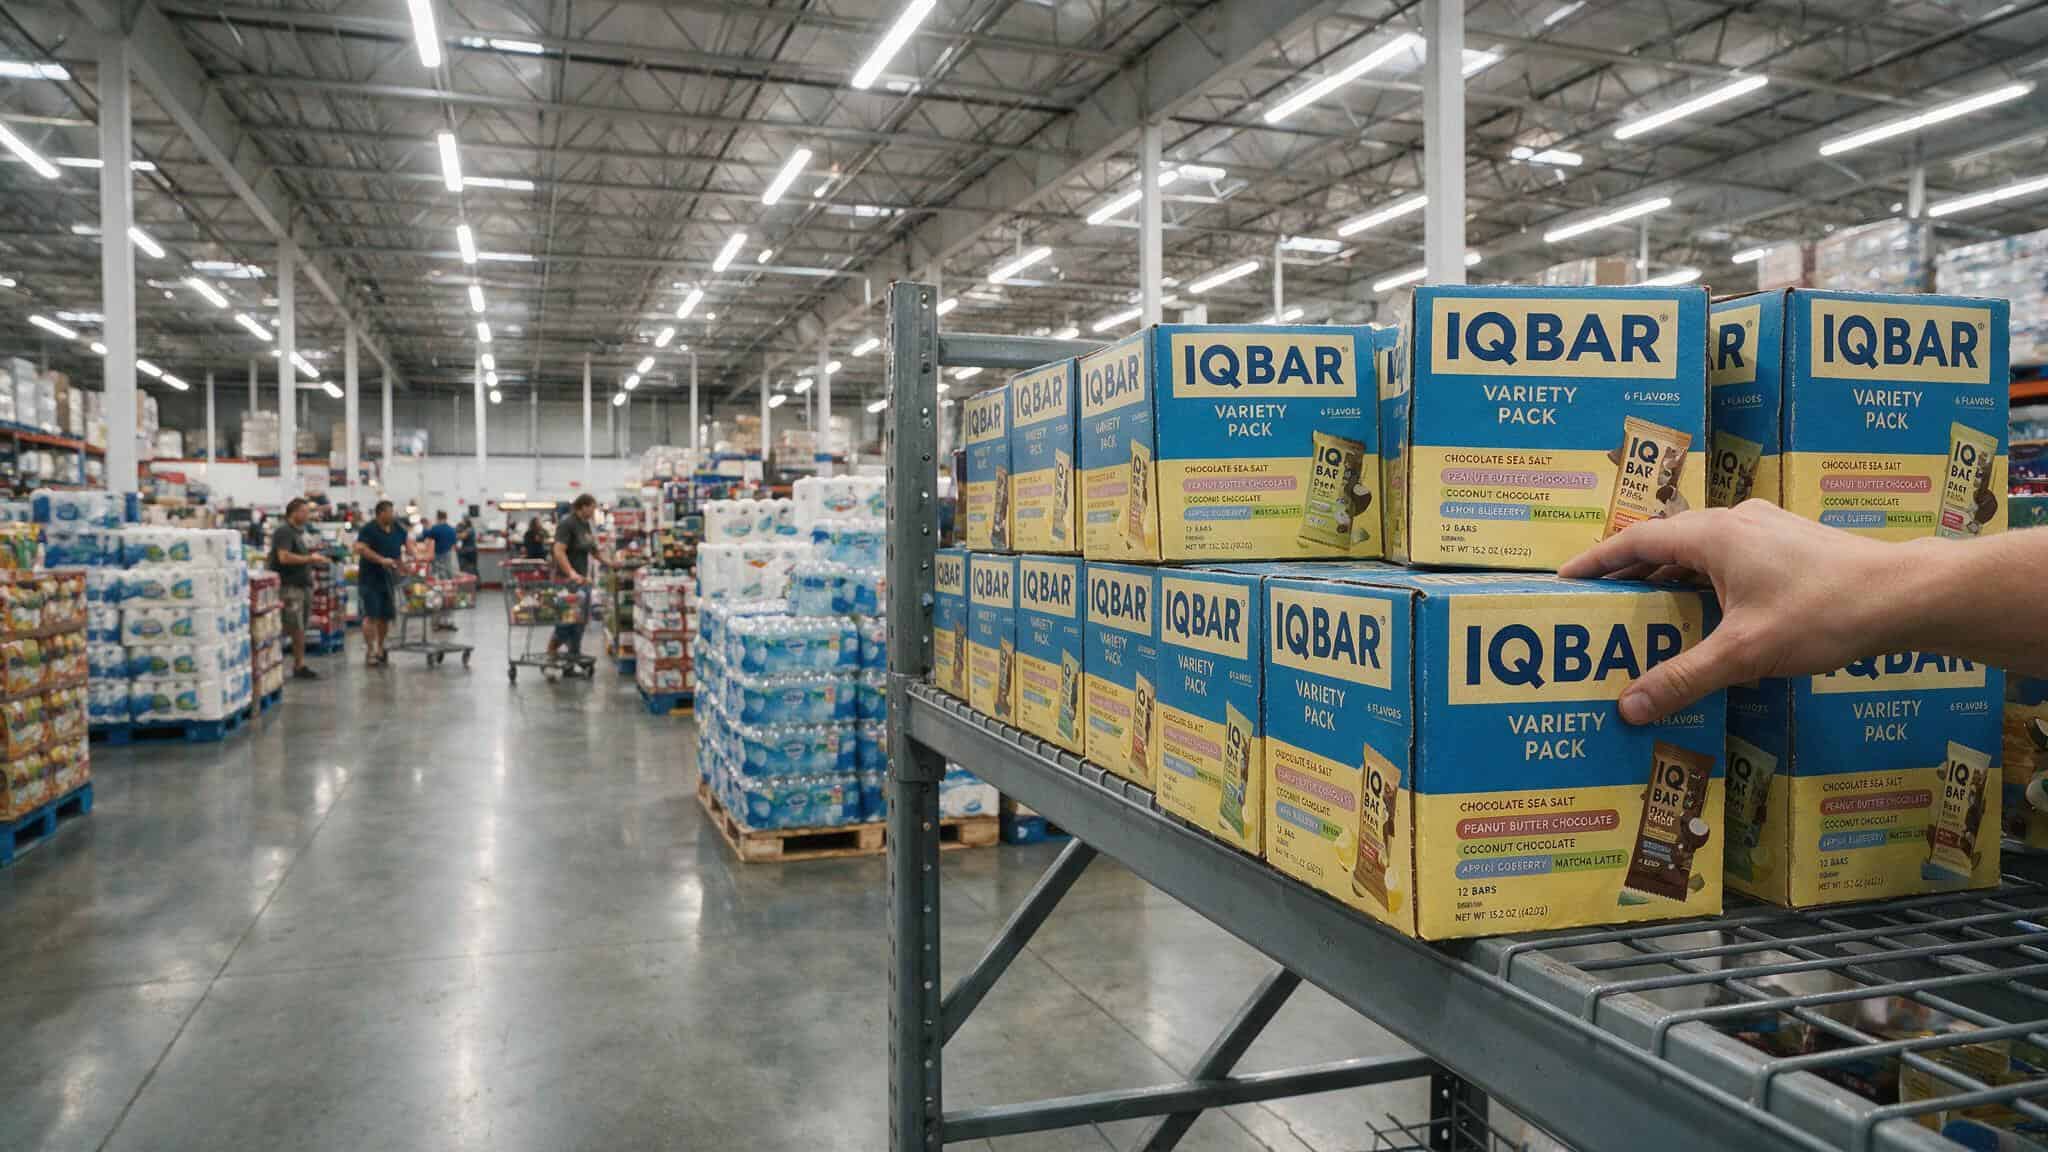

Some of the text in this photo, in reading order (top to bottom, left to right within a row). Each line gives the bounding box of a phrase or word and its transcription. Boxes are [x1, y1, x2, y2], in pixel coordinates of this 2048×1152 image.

[1446, 311, 1661, 366] IQBAR
[1823, 314, 1978, 370] IQBAR
[1184, 344, 1344, 388] IQBAR
[1085, 355, 1139, 407] IQBAR
[1015, 375, 1062, 418] IQBAR
[1483, 384, 1577, 404] VARIETY
[1624, 392, 1680, 401] 6 FLAVORS
[1853, 388, 1923, 408] VARIETY
[968, 403, 1001, 437] IQBAR
[1215, 404, 1287, 420] VARIETY
[1327, 408, 1361, 416] FLAVORS
[1498, 407, 1557, 425] PACK
[1866, 412, 1909, 430] PACK
[1228, 422, 1272, 437] PACK
[1318, 446, 1342, 467] IQ
[1444, 454, 1553, 465] CHOCOLATE SEA SALT
[1629, 437, 1659, 464] IQ
[1954, 441, 1976, 466] IQ
[1184, 464, 1231, 473] CHOCOLATE
[1821, 461, 1867, 470] CHOCOLATE
[1446, 489, 1550, 500] COCONUT CHOCOLATE
[1534, 509, 1601, 519] MATCHA LATTE
[1441, 524, 1477, 533] 12 BARS
[973, 567, 1009, 599] IQBAR
[1024, 570, 1071, 606] IQBAR
[1091, 578, 1146, 622] IQBAR
[1166, 589, 1241, 644] IQBAR
[1277, 601, 1381, 669] IQBAR
[1178, 653, 1214, 677] VARIETY
[1185, 676, 1207, 696] PACK
[1296, 679, 1346, 708] VARIETY
[1304, 706, 1335, 731] PACK
[1852, 699, 1922, 720] VARIETY
[1508, 712, 1607, 736] VARIETY
[1864, 723, 1909, 743] PACK
[1525, 739, 1586, 761] PACK
[1366, 766, 1383, 798] IQ
[1656, 761, 1685, 792] IQ
[1949, 760, 1970, 786] IQ
[1460, 797, 1575, 812] CHOCOLATE SEA SALT
[1464, 815, 1613, 834] PEANUT BUTTER CHOCOLATE
[1463, 838, 1576, 854] COCONUT CHOCOLATE
[1555, 854, 1623, 868] MATCHA LATTE
[1458, 885, 1497, 897] 12 BARS
[1455, 912, 1470, 922] NET
[1474, 911, 1486, 920] WT
